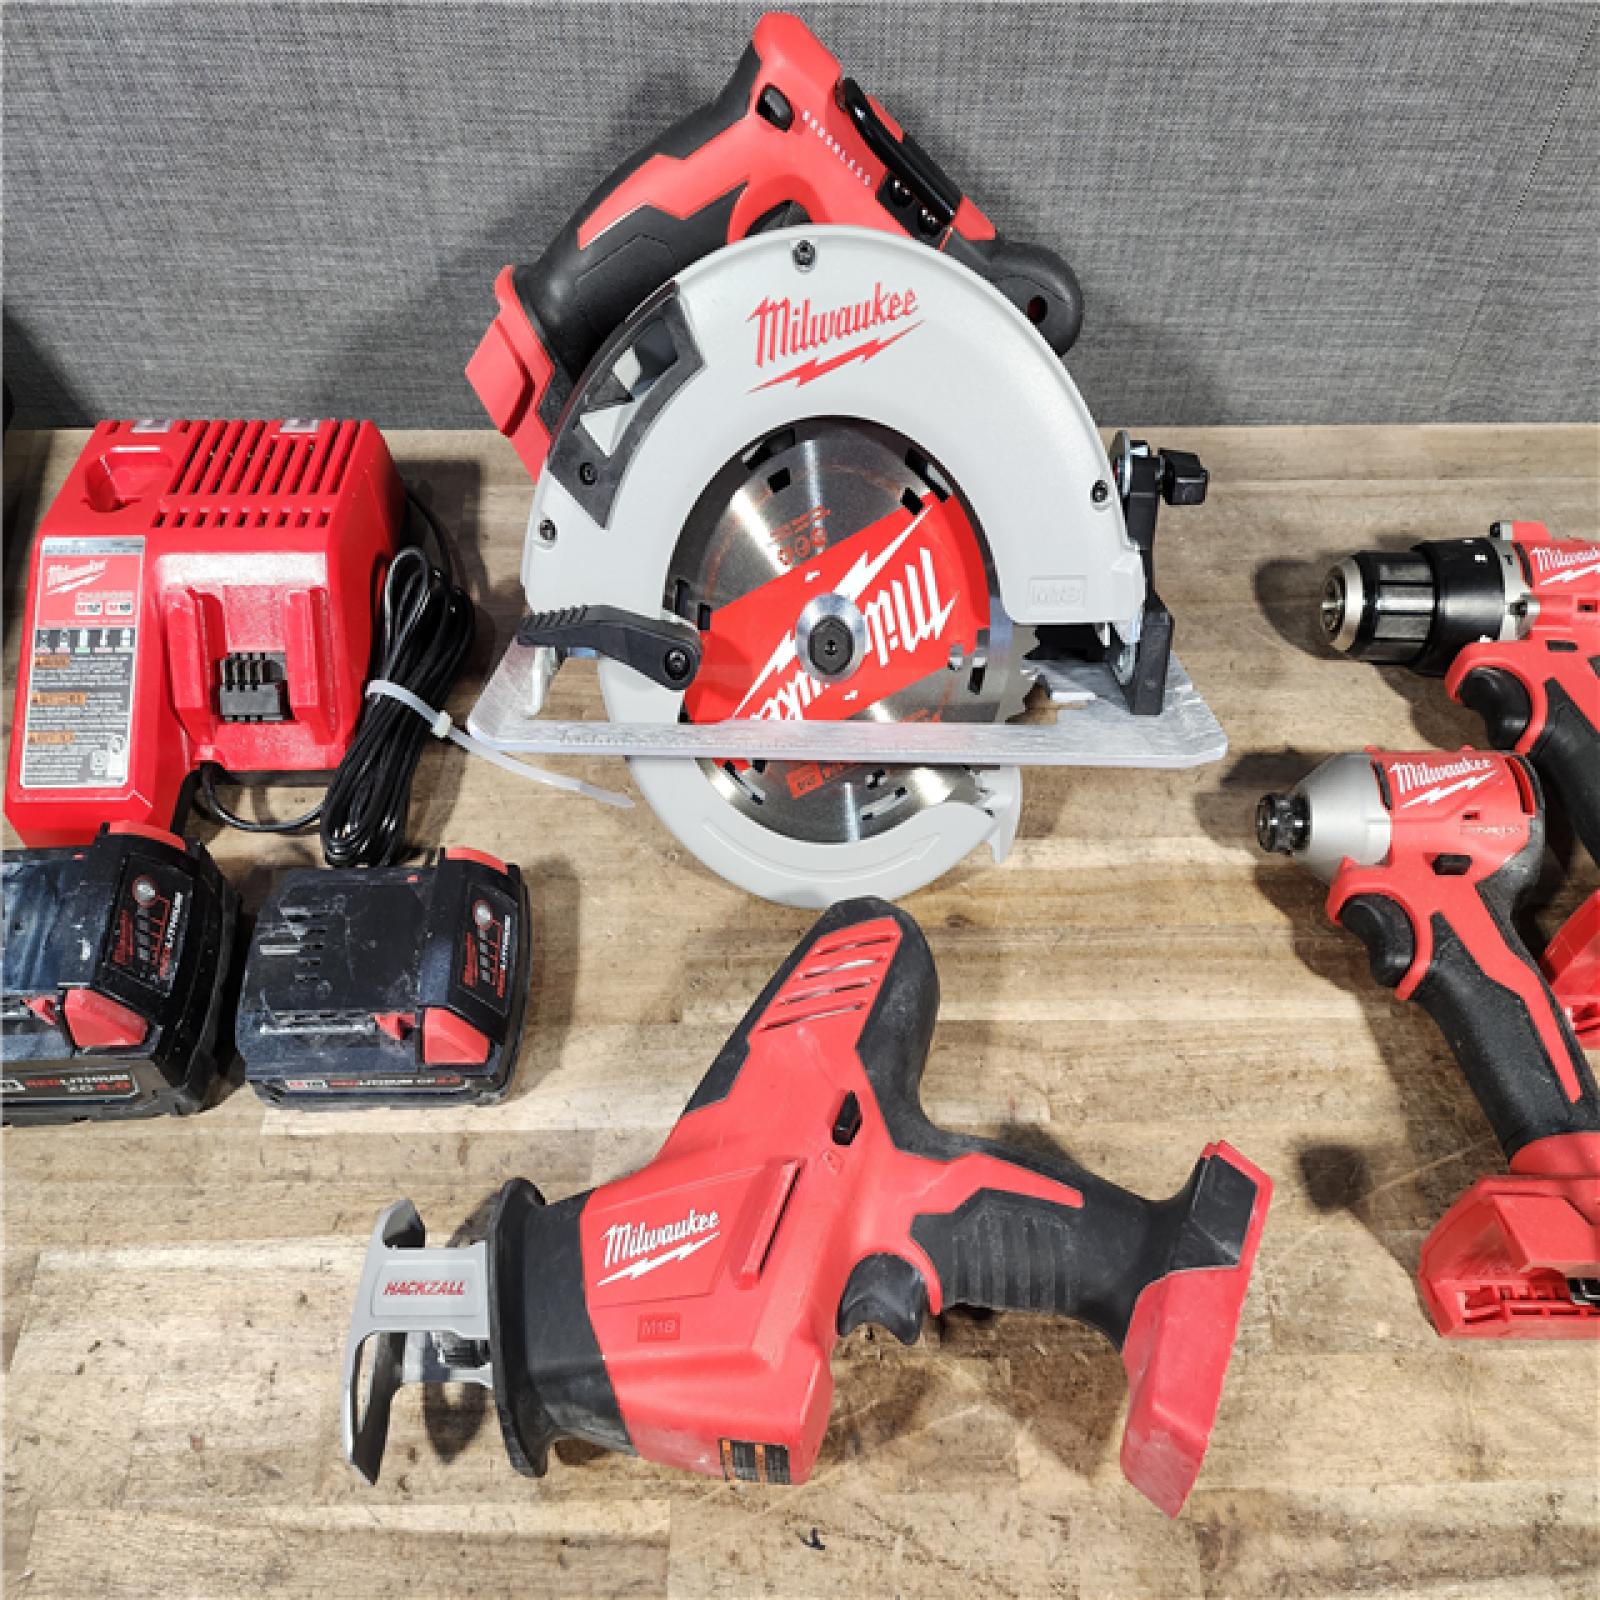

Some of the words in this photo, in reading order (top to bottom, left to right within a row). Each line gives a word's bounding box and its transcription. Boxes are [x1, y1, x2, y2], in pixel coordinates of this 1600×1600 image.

[746, 281, 919, 368] Milwaukee
[1389, 757, 1493, 795] Milwaukee
[600, 1207, 720, 1268] Milwaukee
[383, 1279, 465, 1296] HACKZALL
